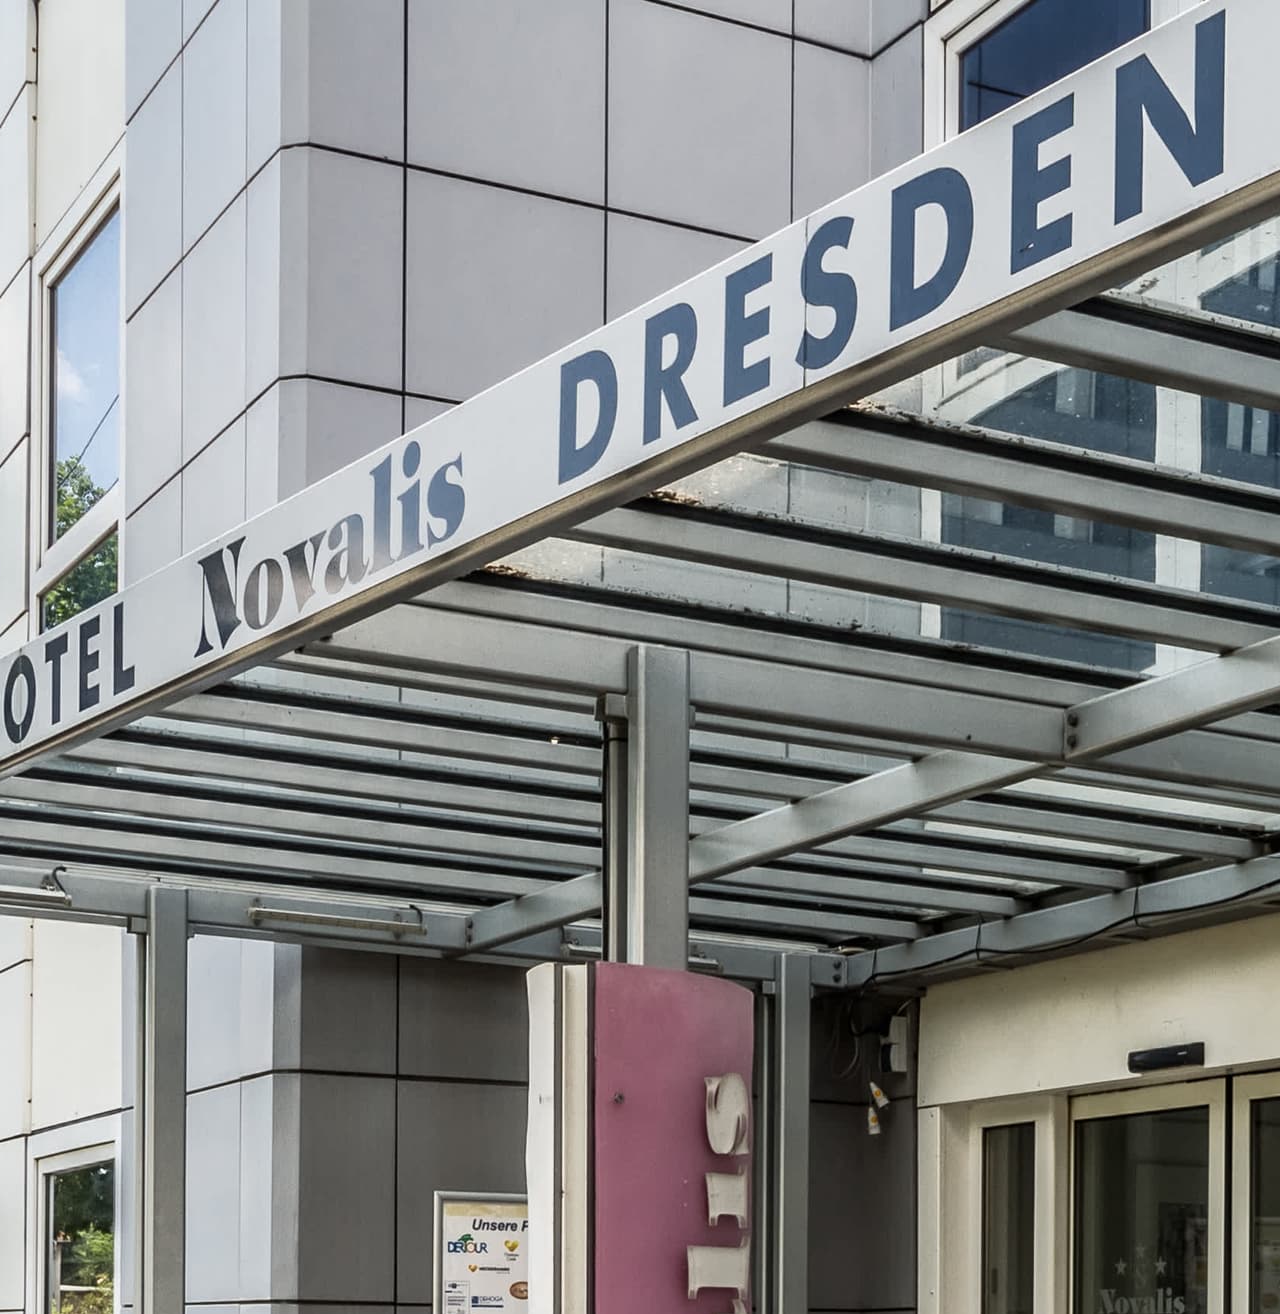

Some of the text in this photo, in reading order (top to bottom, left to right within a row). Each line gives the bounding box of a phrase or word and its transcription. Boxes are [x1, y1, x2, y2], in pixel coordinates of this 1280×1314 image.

[193, 440, 467, 659] Novalis
[558, 9, 1226, 485] DRESDEN
[472, 1218, 518, 1232] Unsere
